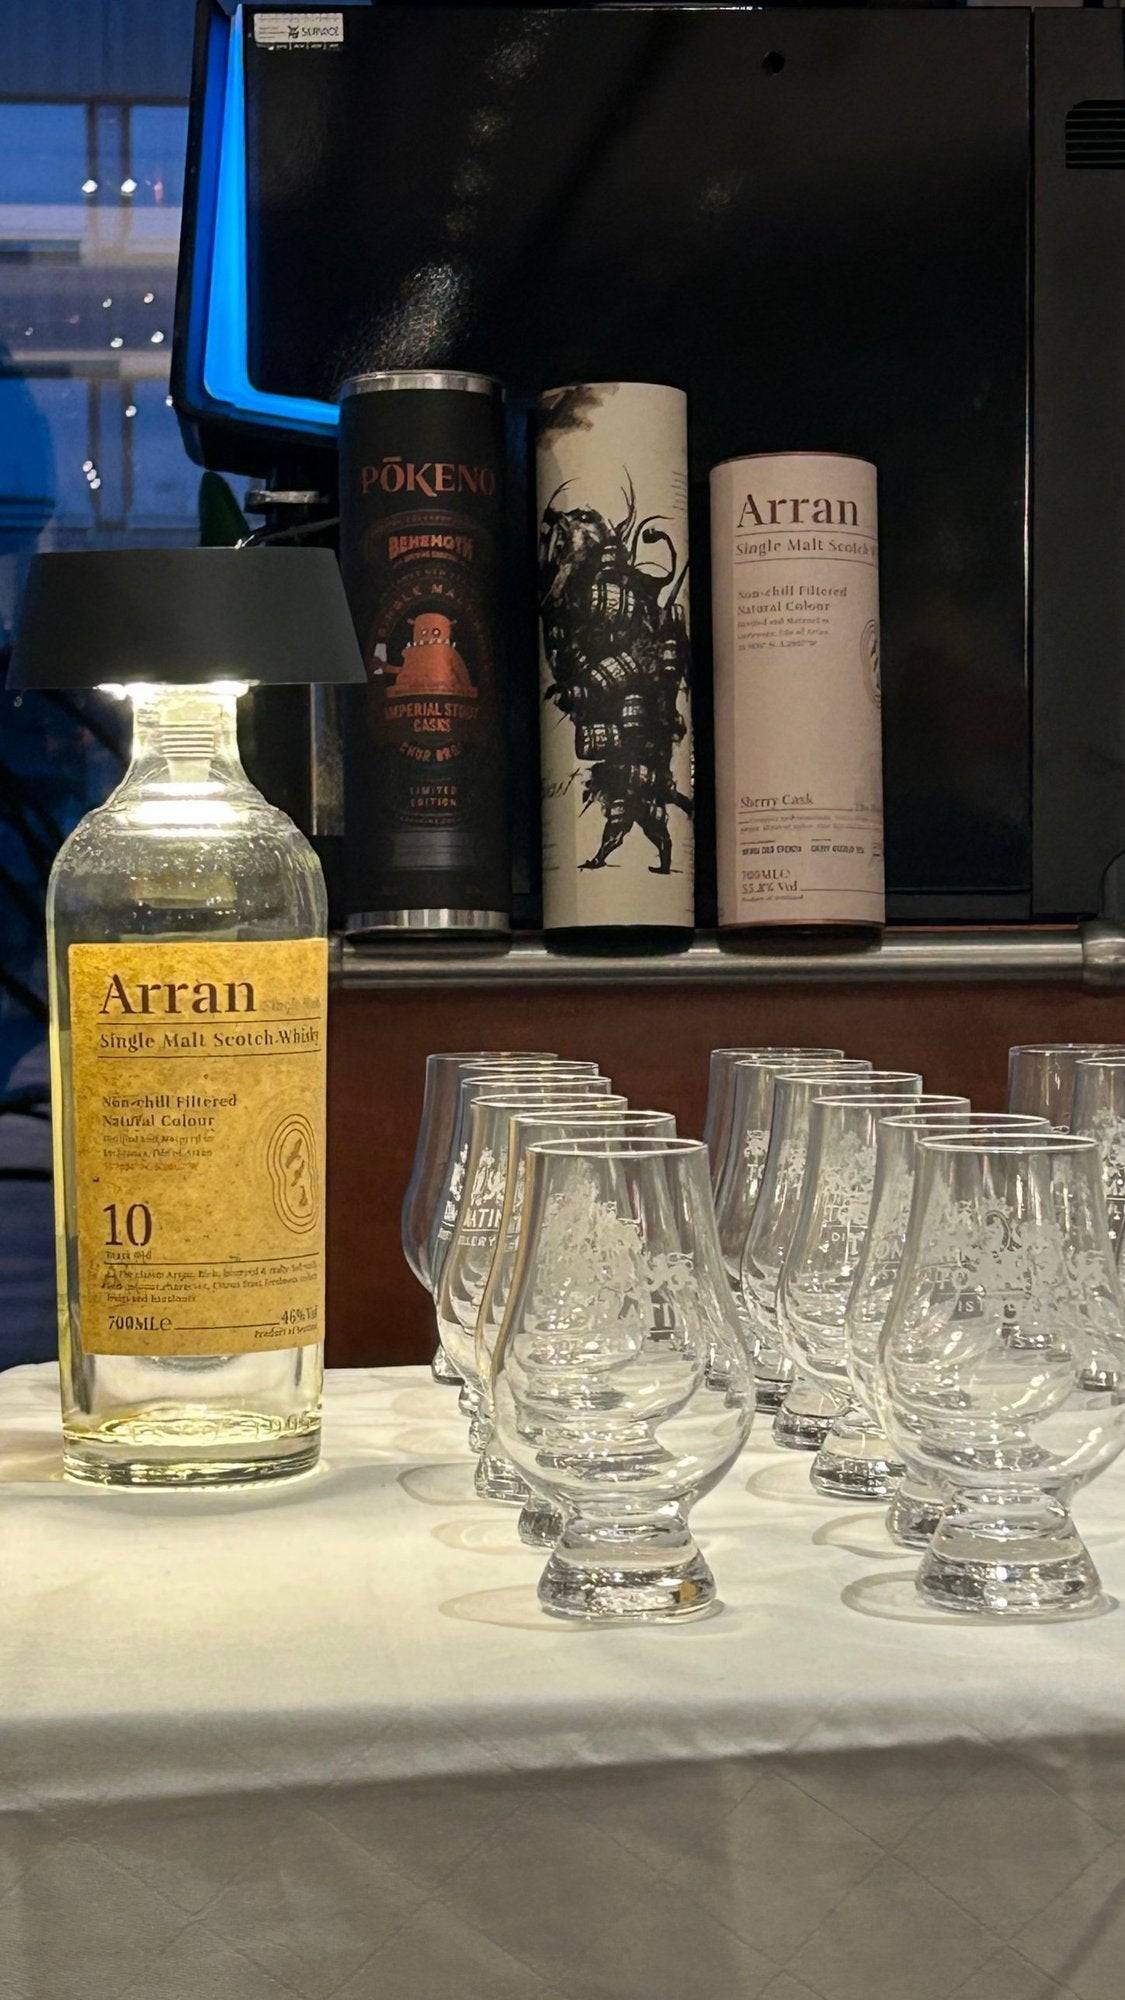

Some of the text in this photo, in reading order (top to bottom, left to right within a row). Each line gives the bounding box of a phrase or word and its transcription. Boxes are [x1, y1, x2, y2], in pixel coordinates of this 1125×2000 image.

[361, 456, 495, 496] PŌKENO
[737, 493, 860, 528] Arran
[388, 535, 474, 561] BEHEMOTH
[736, 539, 782, 557] Single
[787, 537, 824, 551] Malt
[738, 585, 848, 599] Non-chill Filtered
[737, 600, 830, 615] Natural Colour
[385, 703, 442, 720] IMPERIAL
[410, 786, 457, 795] LIMITED
[411, 798, 457, 807] EDITION
[741, 792, 814, 809] Sherry Cask
[99, 974, 257, 1014] Arran
[100, 1026, 319, 1052] Single Malt Scotch Whisky
[102, 1094, 237, 1109] Non-chill Filtered
[102, 1114, 216, 1127] Natural Colour
[103, 1203, 153, 1246] 10
